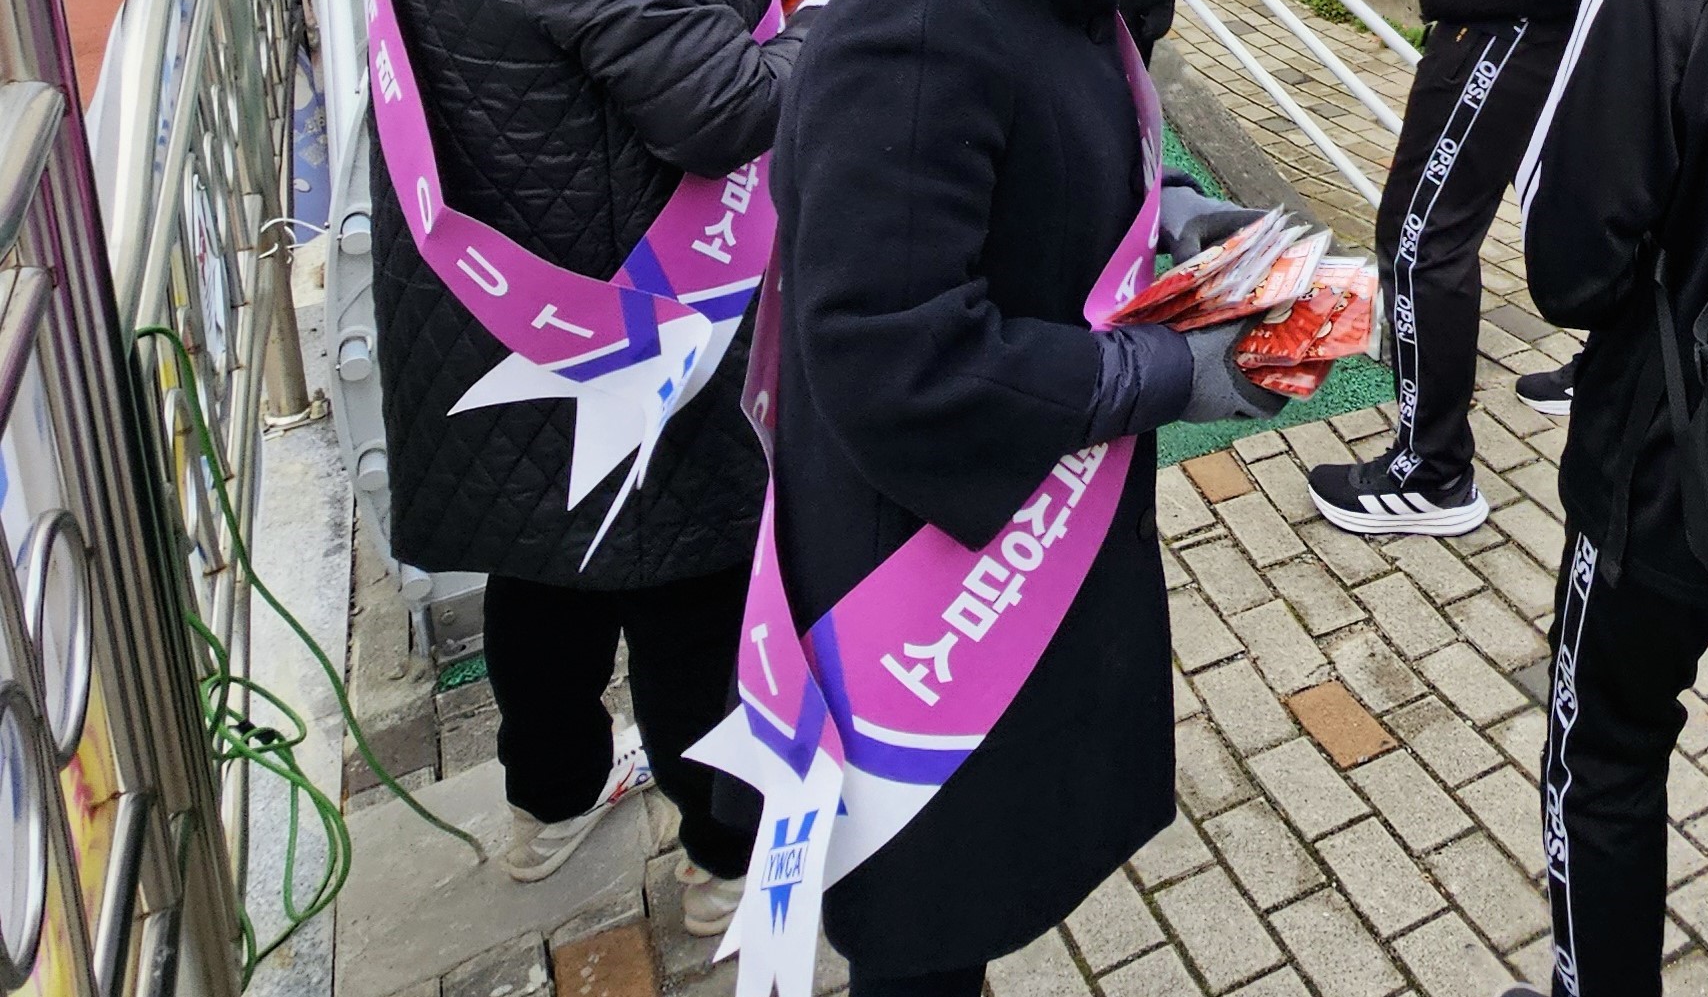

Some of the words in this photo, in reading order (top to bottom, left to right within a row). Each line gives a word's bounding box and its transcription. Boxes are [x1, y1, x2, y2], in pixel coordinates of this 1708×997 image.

[1463, 60, 1496, 108] OPSJ
[1426, 138, 1458, 185] OPSJ
[691, 156, 761, 264] 담소
[417, 176, 594, 339] OUT
[1399, 213, 1422, 262] OPSJ
[1397, 294, 1414, 344] OPSJ
[1401, 379, 1416, 428] OPSJ
[880, 442, 1108, 706] 력상담소
[1573, 535, 1595, 600] PSJ
[767, 848, 803, 882] YWCA
[1556, 946, 1578, 997] OP
